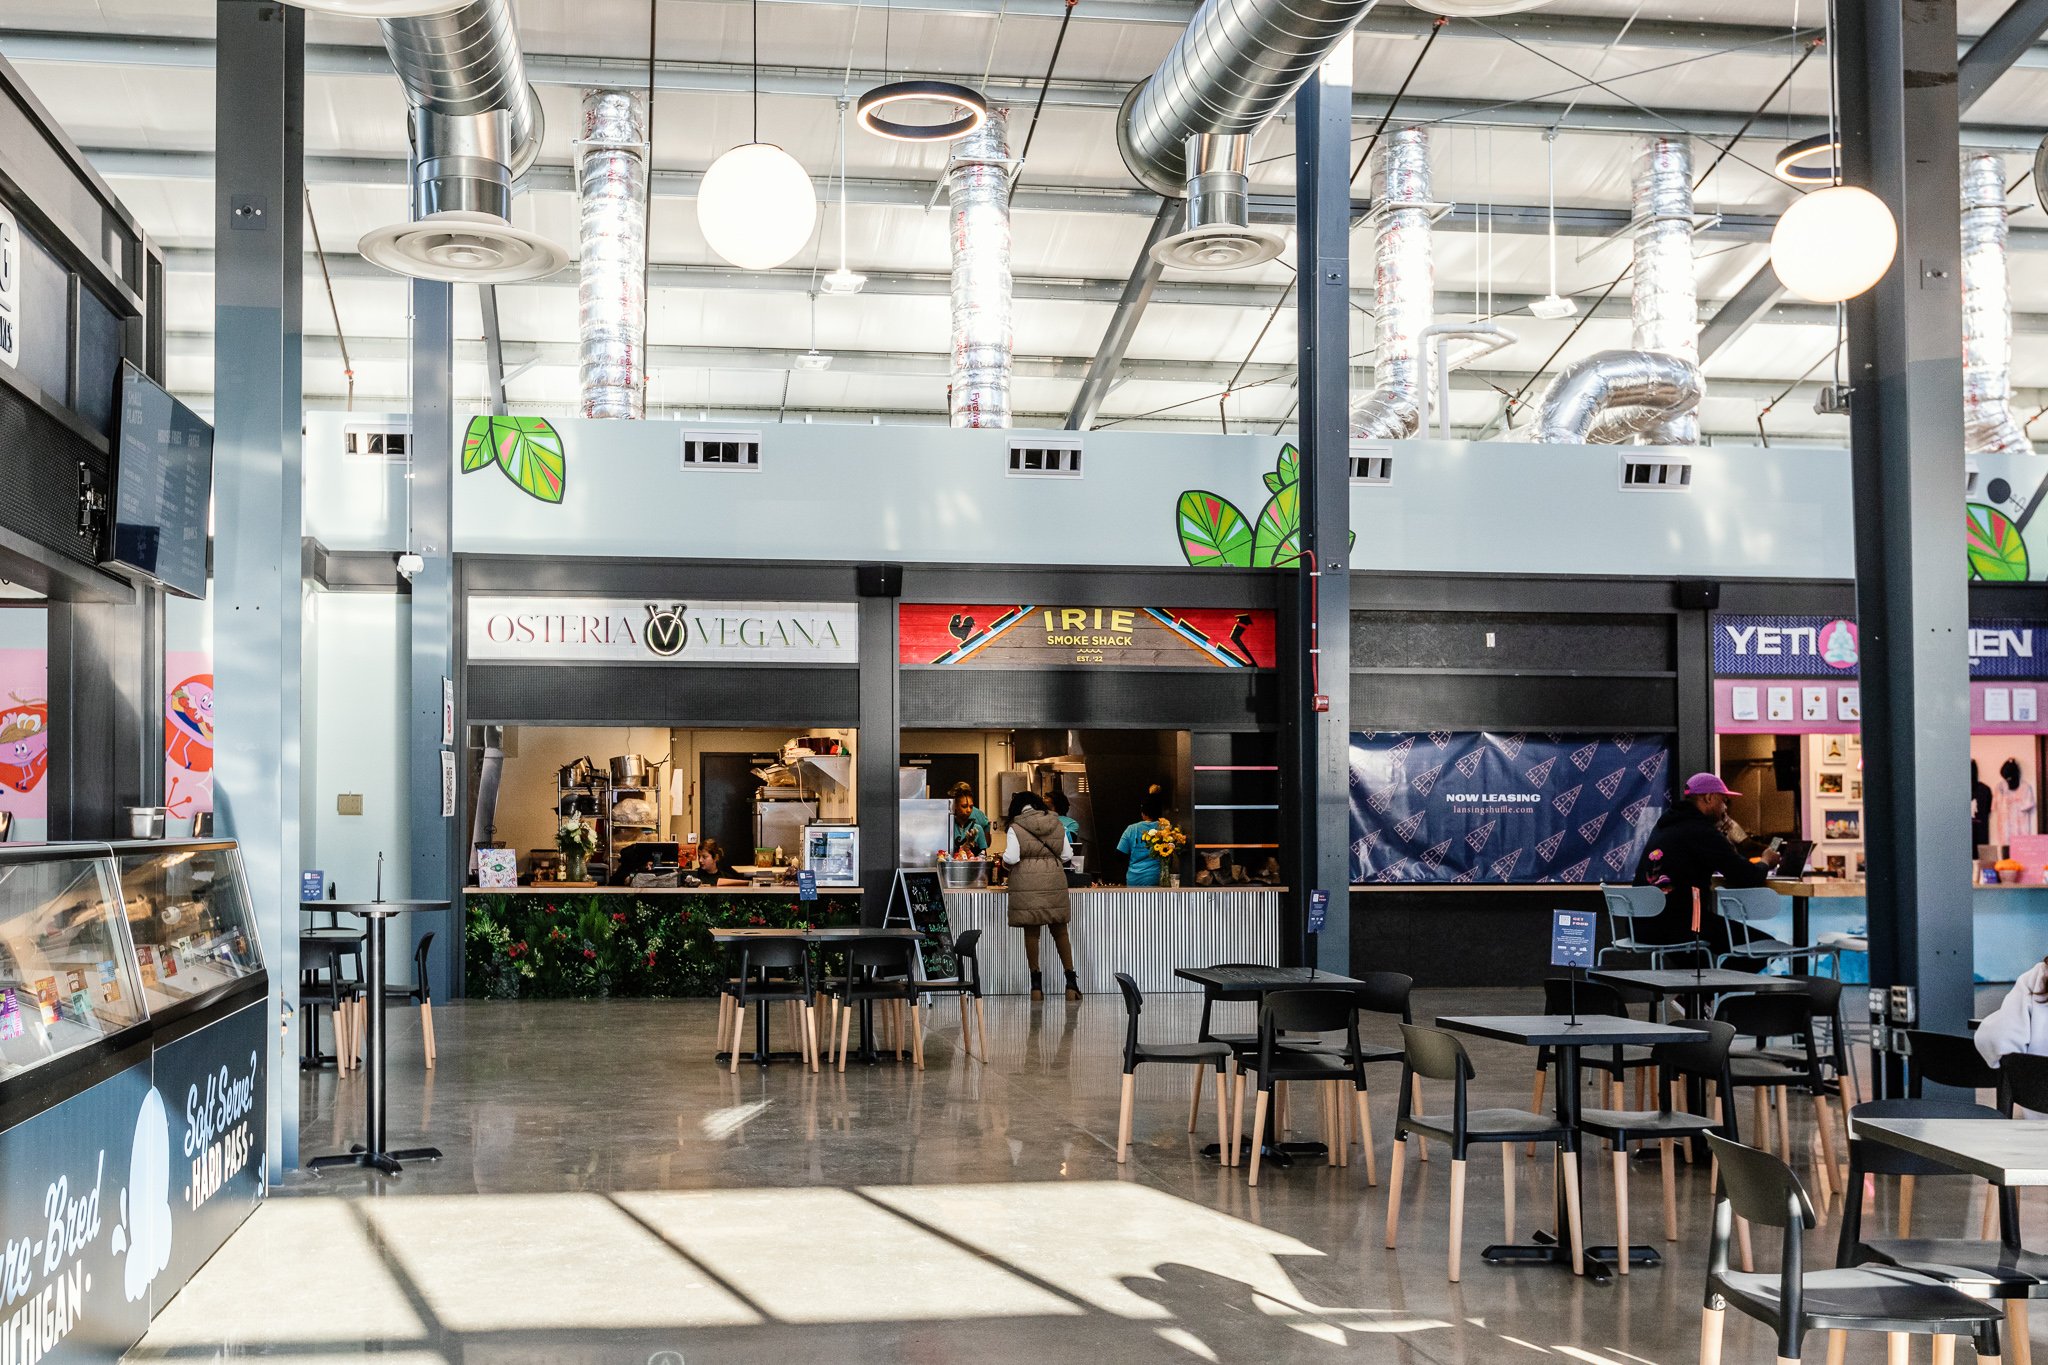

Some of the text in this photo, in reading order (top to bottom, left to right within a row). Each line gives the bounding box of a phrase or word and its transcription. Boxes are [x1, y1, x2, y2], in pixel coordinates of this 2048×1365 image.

[487, 614, 637, 645] OSTERIA
[694, 617, 841, 648] VEGANA
[1043, 608, 1135, 633] IRIE
[1047, 635, 1132, 646] SMOKE SHACK
[1725, 626, 1816, 656] YETI
[1446, 793, 1541, 802] NOW LEASING
[1453, 805, 1534, 815] lansingshuffle.com
[184, 1050, 257, 1167] Soft Serve?
[192, 1120, 248, 1212] HARD PASS
[0, 1259, 82, 1365] ICHIGAN
